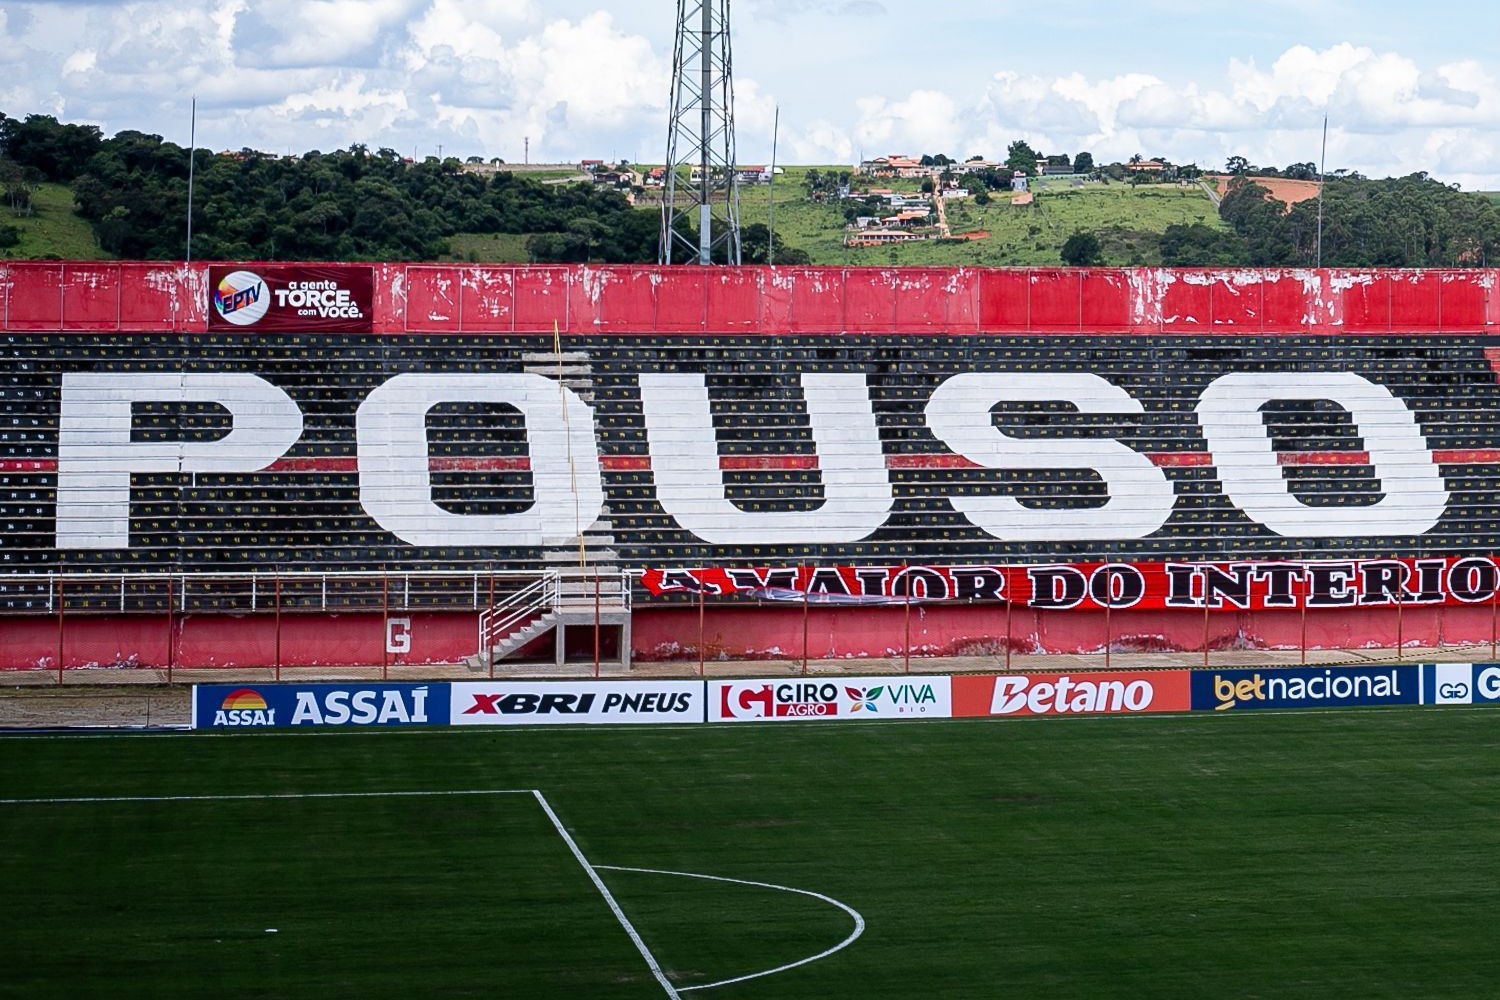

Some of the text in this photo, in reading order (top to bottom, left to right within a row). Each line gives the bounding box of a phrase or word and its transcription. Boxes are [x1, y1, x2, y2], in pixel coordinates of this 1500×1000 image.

[288, 280, 337, 291] a gente
[222, 281, 262, 315] EPTV
[275, 290, 350, 307] TORCE
[55, 372, 1450, 549] POUSO
[724, 565, 1007, 602] MAIOR
[1027, 562, 1146, 610] DO
[386, 618, 411, 653] G
[461, 692, 693, 715] XBRI PNEUS
[776, 683, 838, 703] GIRO
[887, 684, 936, 704] VIVA
[989, 675, 1154, 715] Betano
[290, 685, 429, 725] ASSAÍ
[786, 703, 827, 716] AGRO
[213, 708, 275, 726] ASSAÍ
